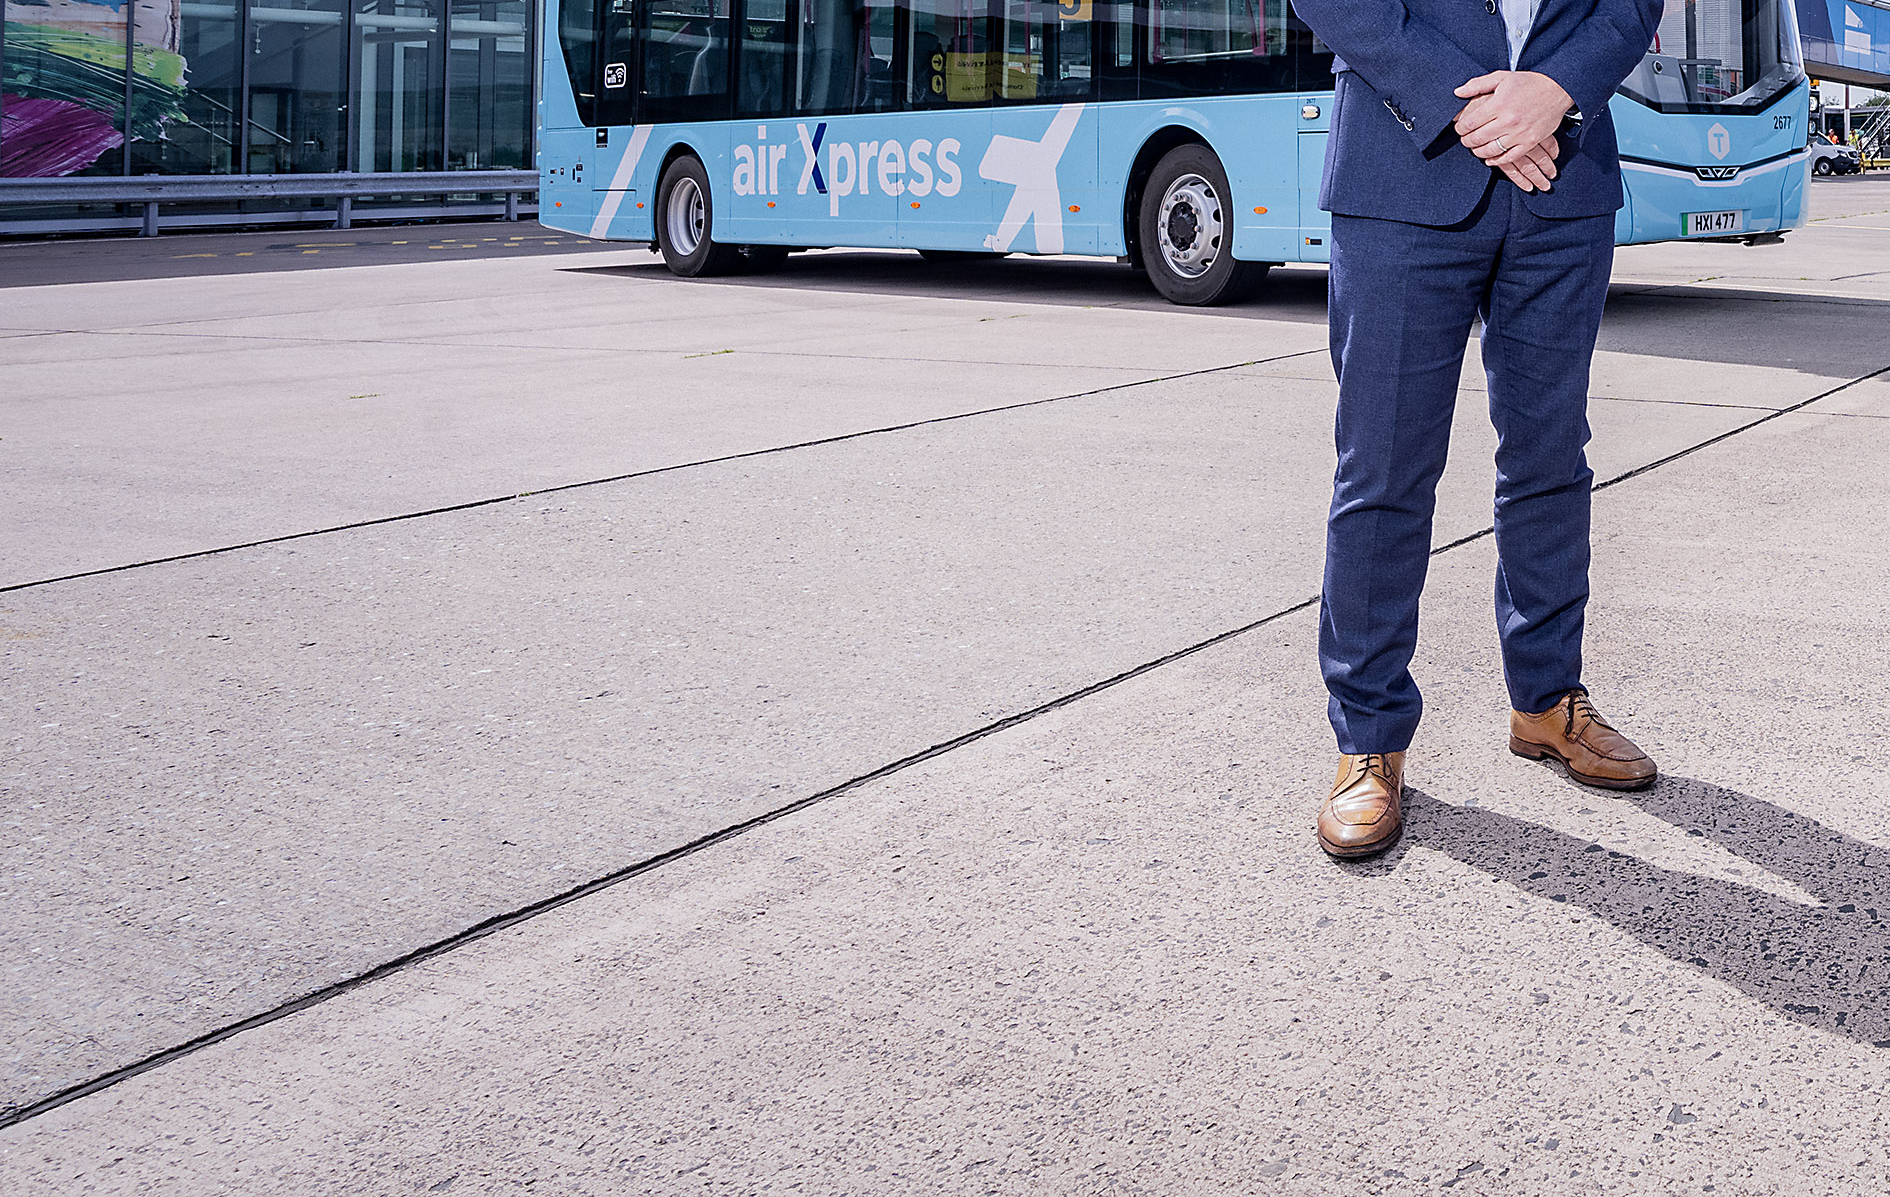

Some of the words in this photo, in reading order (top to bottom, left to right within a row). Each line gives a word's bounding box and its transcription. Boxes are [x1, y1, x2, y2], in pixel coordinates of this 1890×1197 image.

[1773, 115, 1792, 130] 2677
[732, 124, 787, 197] air
[796, 122, 963, 217] Xpress
[1695, 215, 1713, 231] HXI
[1715, 213, 1736, 230] 477
